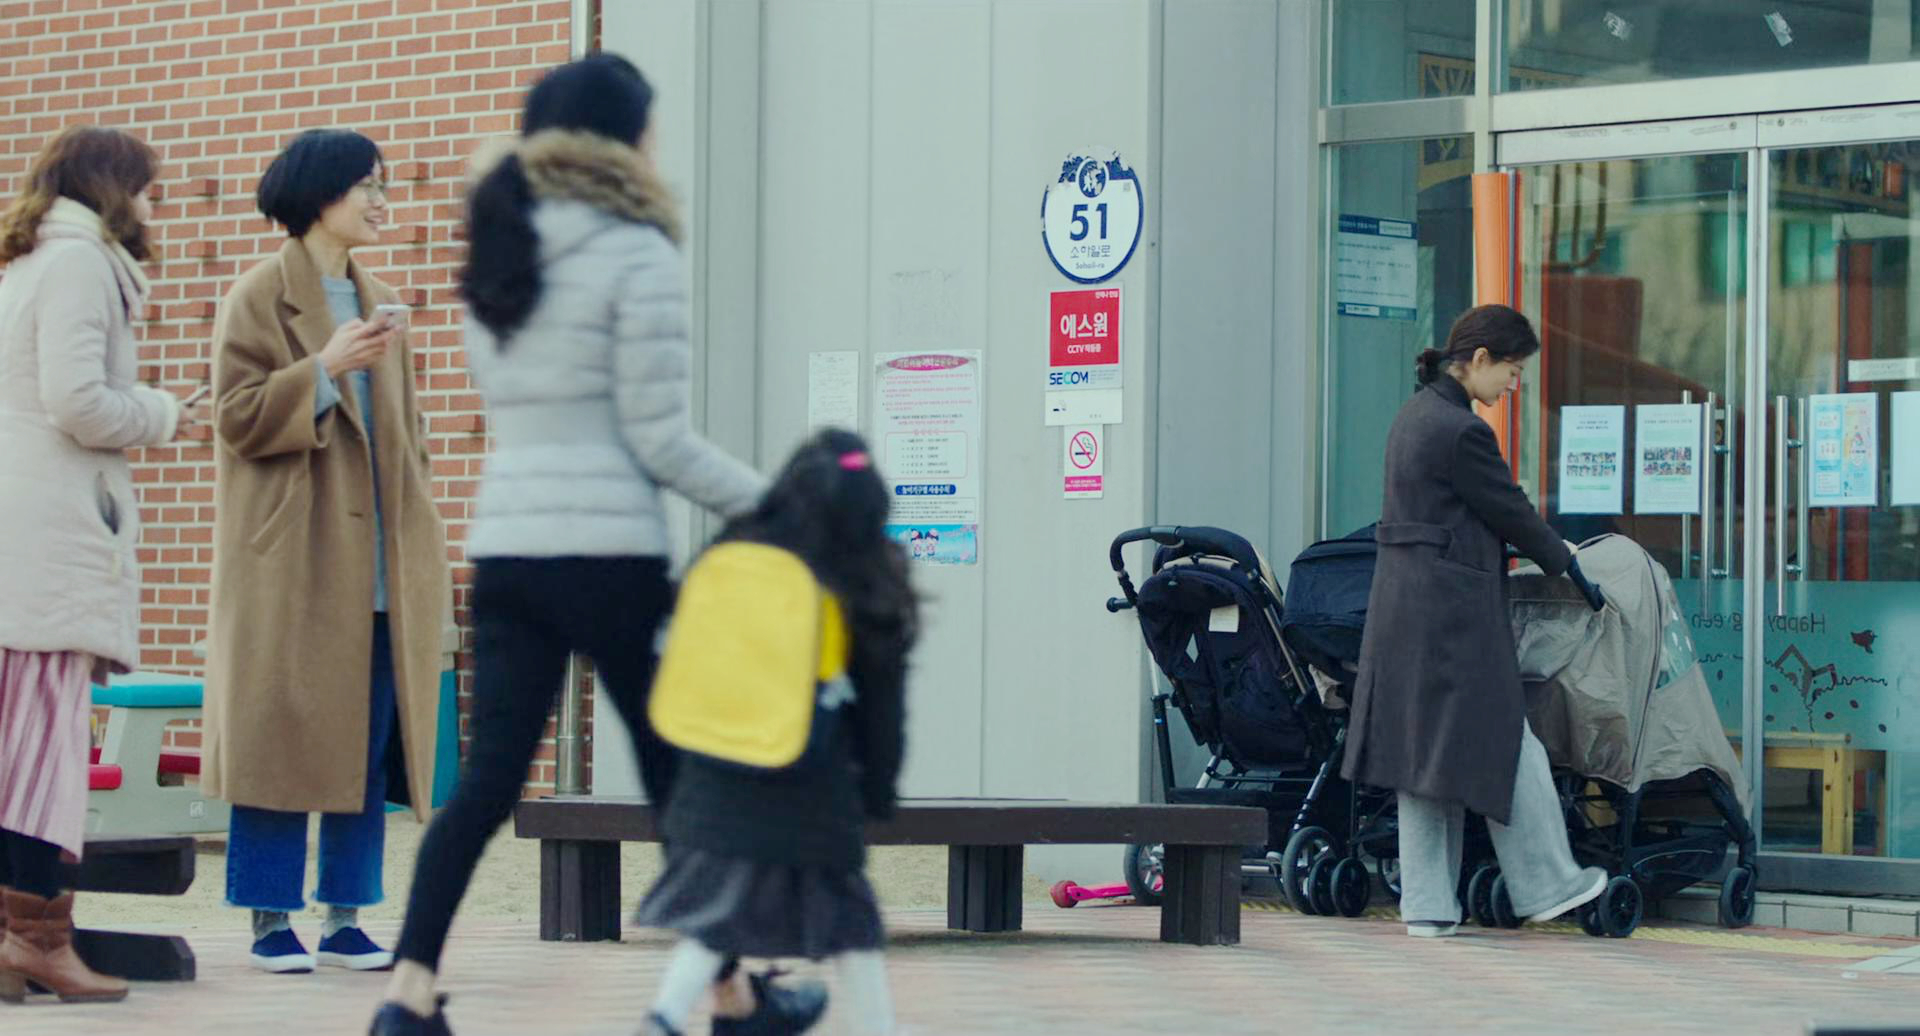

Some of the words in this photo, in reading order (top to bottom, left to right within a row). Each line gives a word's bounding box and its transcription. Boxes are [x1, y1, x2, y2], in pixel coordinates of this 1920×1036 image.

[1069, 203, 1108, 241] 51
[1060, 312, 1108, 339] 에스원
[1067, 344, 1085, 354] CCTV
[1049, 371, 1089, 385] SECOM
